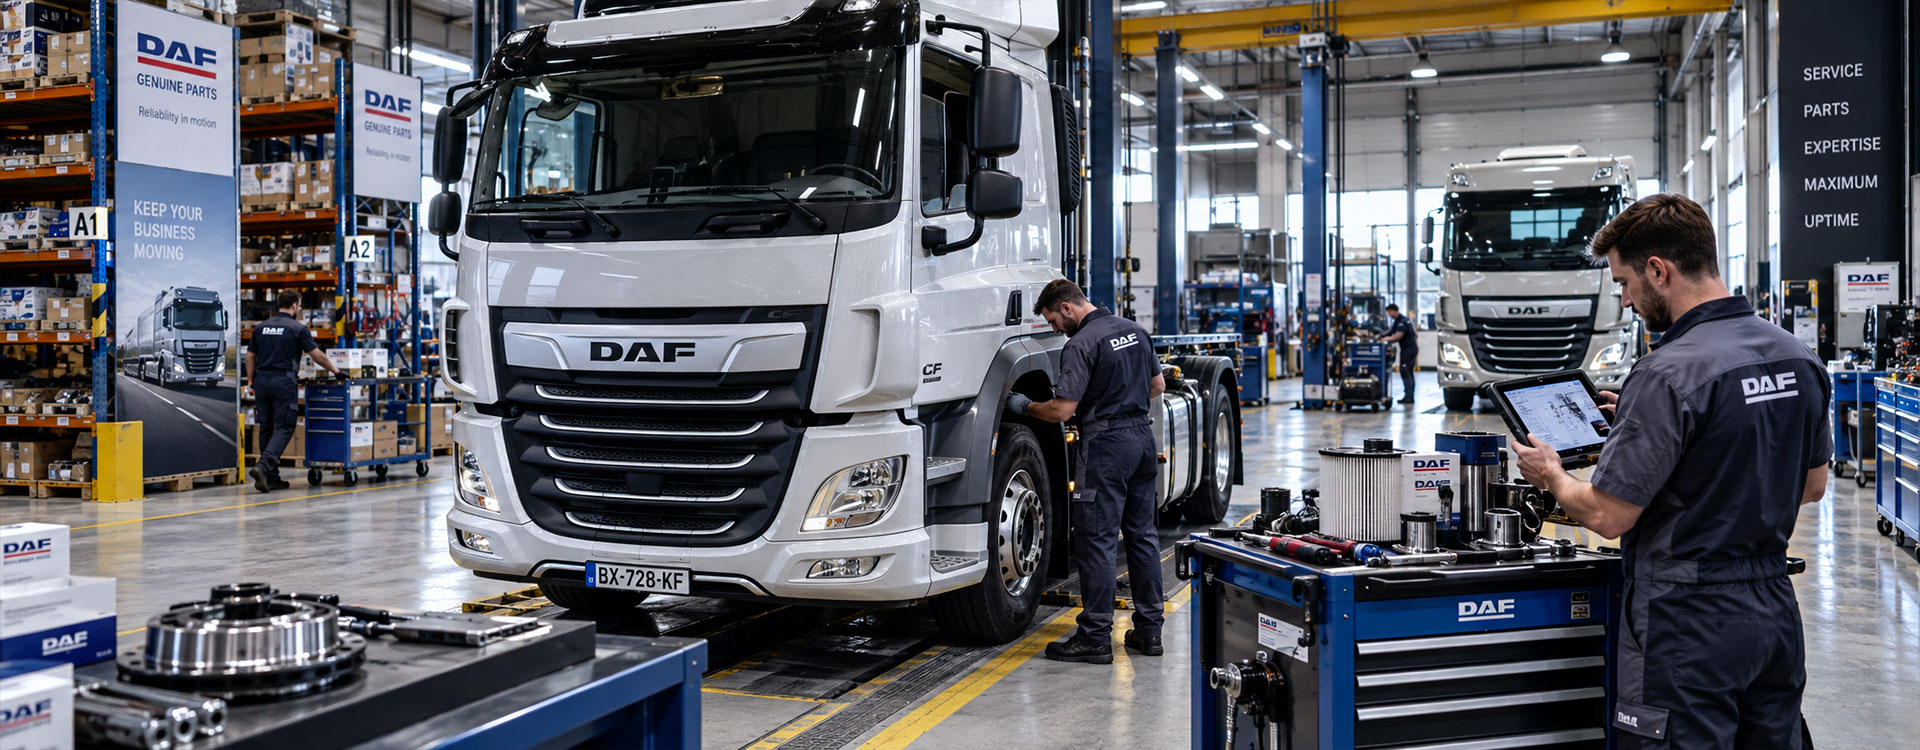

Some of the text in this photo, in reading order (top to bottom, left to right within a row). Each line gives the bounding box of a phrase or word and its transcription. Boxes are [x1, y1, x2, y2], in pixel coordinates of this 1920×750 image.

[137, 32, 217, 67] DAF
[1803, 63, 1864, 82] SERVICE
[136, 73, 218, 101] GENUINE PARTS
[364, 89, 412, 113] DAF
[1804, 101, 1850, 118] PARTS
[180, 113, 189, 124] in
[189, 116, 217, 129] motion
[364, 120, 413, 140] GENUINE PARTS
[1804, 137, 1882, 155] EXPERTISE
[1804, 174, 1879, 192] MAXIMUM
[133, 200, 203, 222] KEEP YOUR
[1804, 213, 1860, 228] UPTIME
[74, 211, 97, 236] A1
[133, 221, 196, 241] BUSINESS
[133, 242, 184, 261] MOVING
[348, 239, 371, 259] A2
[1847, 273, 1890, 282] DAF
[1508, 306, 1550, 315] DAF
[1110, 333, 1137, 348] DAF
[590, 341, 696, 363] DAF
[922, 362, 943, 376] CF
[1741, 371, 1797, 397] DAF
[1413, 459, 1450, 469] DAF
[3, 538, 51, 554] DAF
[598, 566, 684, 591] BX-728-KF
[1458, 599, 1515, 617] DAF
[42, 630, 88, 651] DAF
